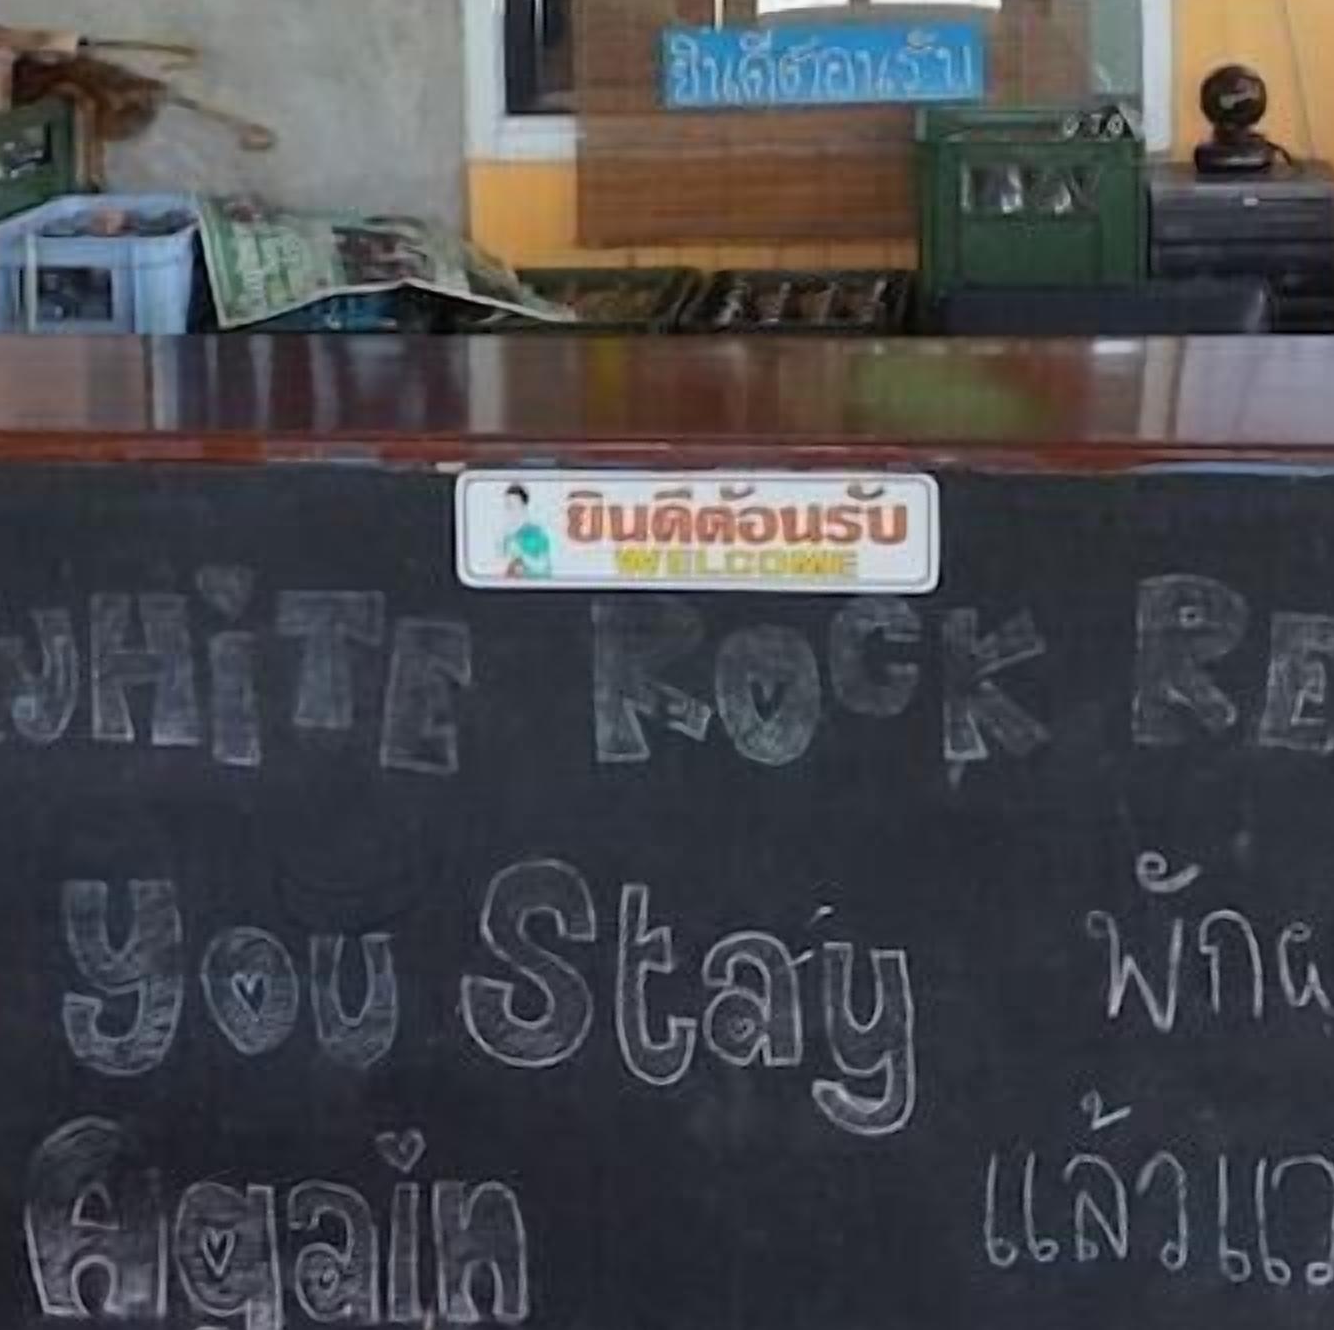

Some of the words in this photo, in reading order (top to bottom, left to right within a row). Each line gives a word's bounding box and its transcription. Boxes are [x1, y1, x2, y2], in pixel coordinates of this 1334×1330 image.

[566, 484, 908, 545] ยินดีต้อนรับ
[616, 546, 861, 580] WELCOME
[590, 593, 1050, 767] ROCK
[461, 857, 917, 1136] Stay
[24, 1116, 533, 1330] Again
